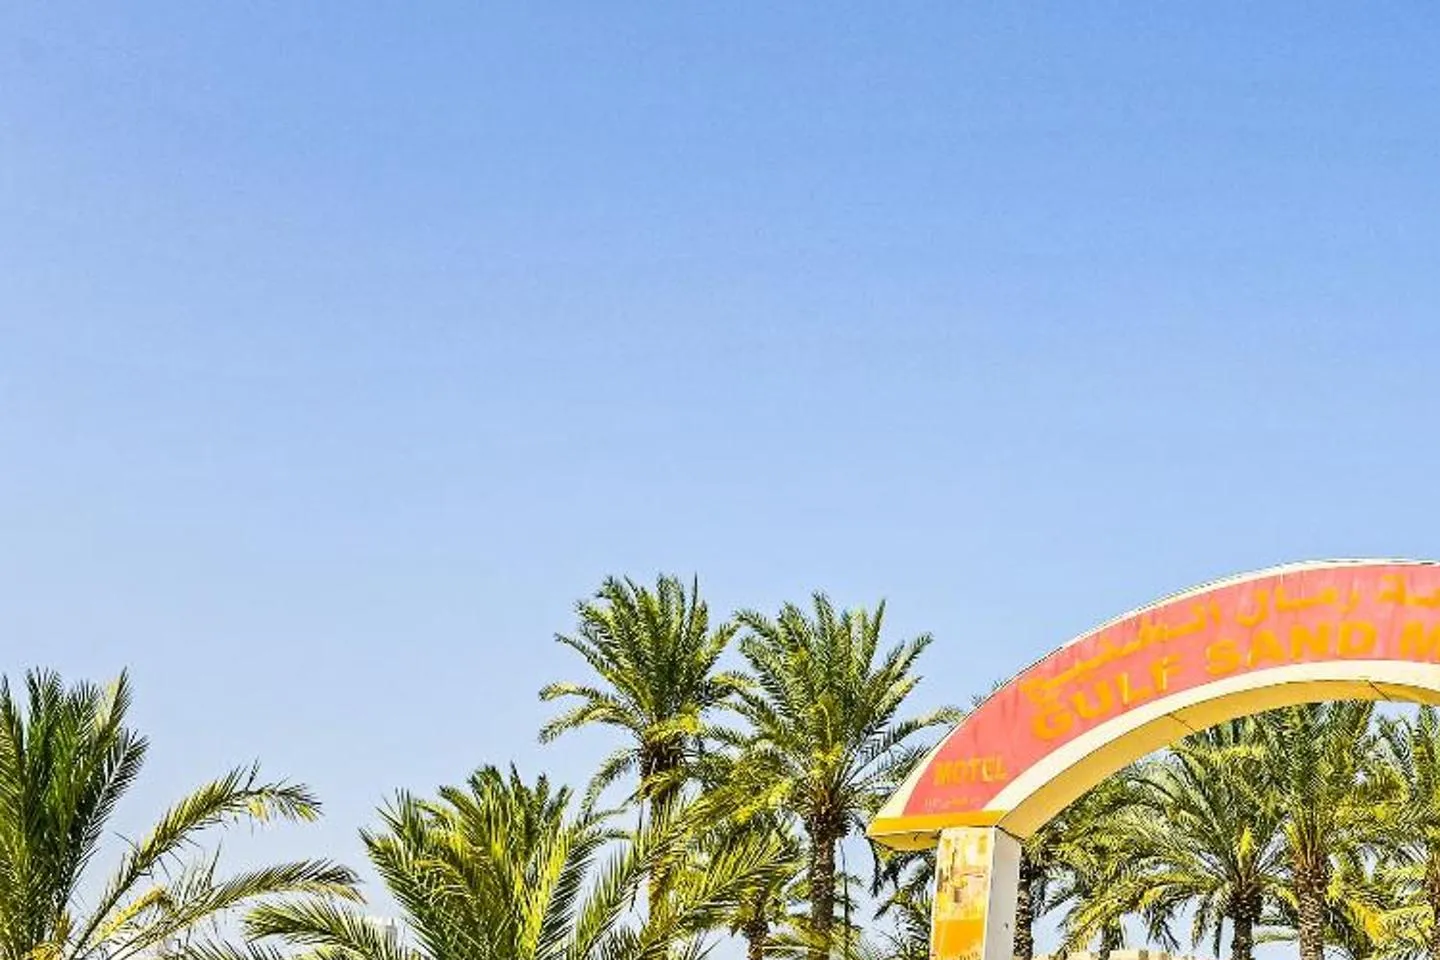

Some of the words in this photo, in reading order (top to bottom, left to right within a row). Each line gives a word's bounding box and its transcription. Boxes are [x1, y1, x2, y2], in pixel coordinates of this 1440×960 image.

[1235, 583, 1360, 627] رمال
[1030, 653, 1185, 740] GULF
[1204, 619, 1377, 676] SAND
[933, 752, 1007, 787] MOTEL
